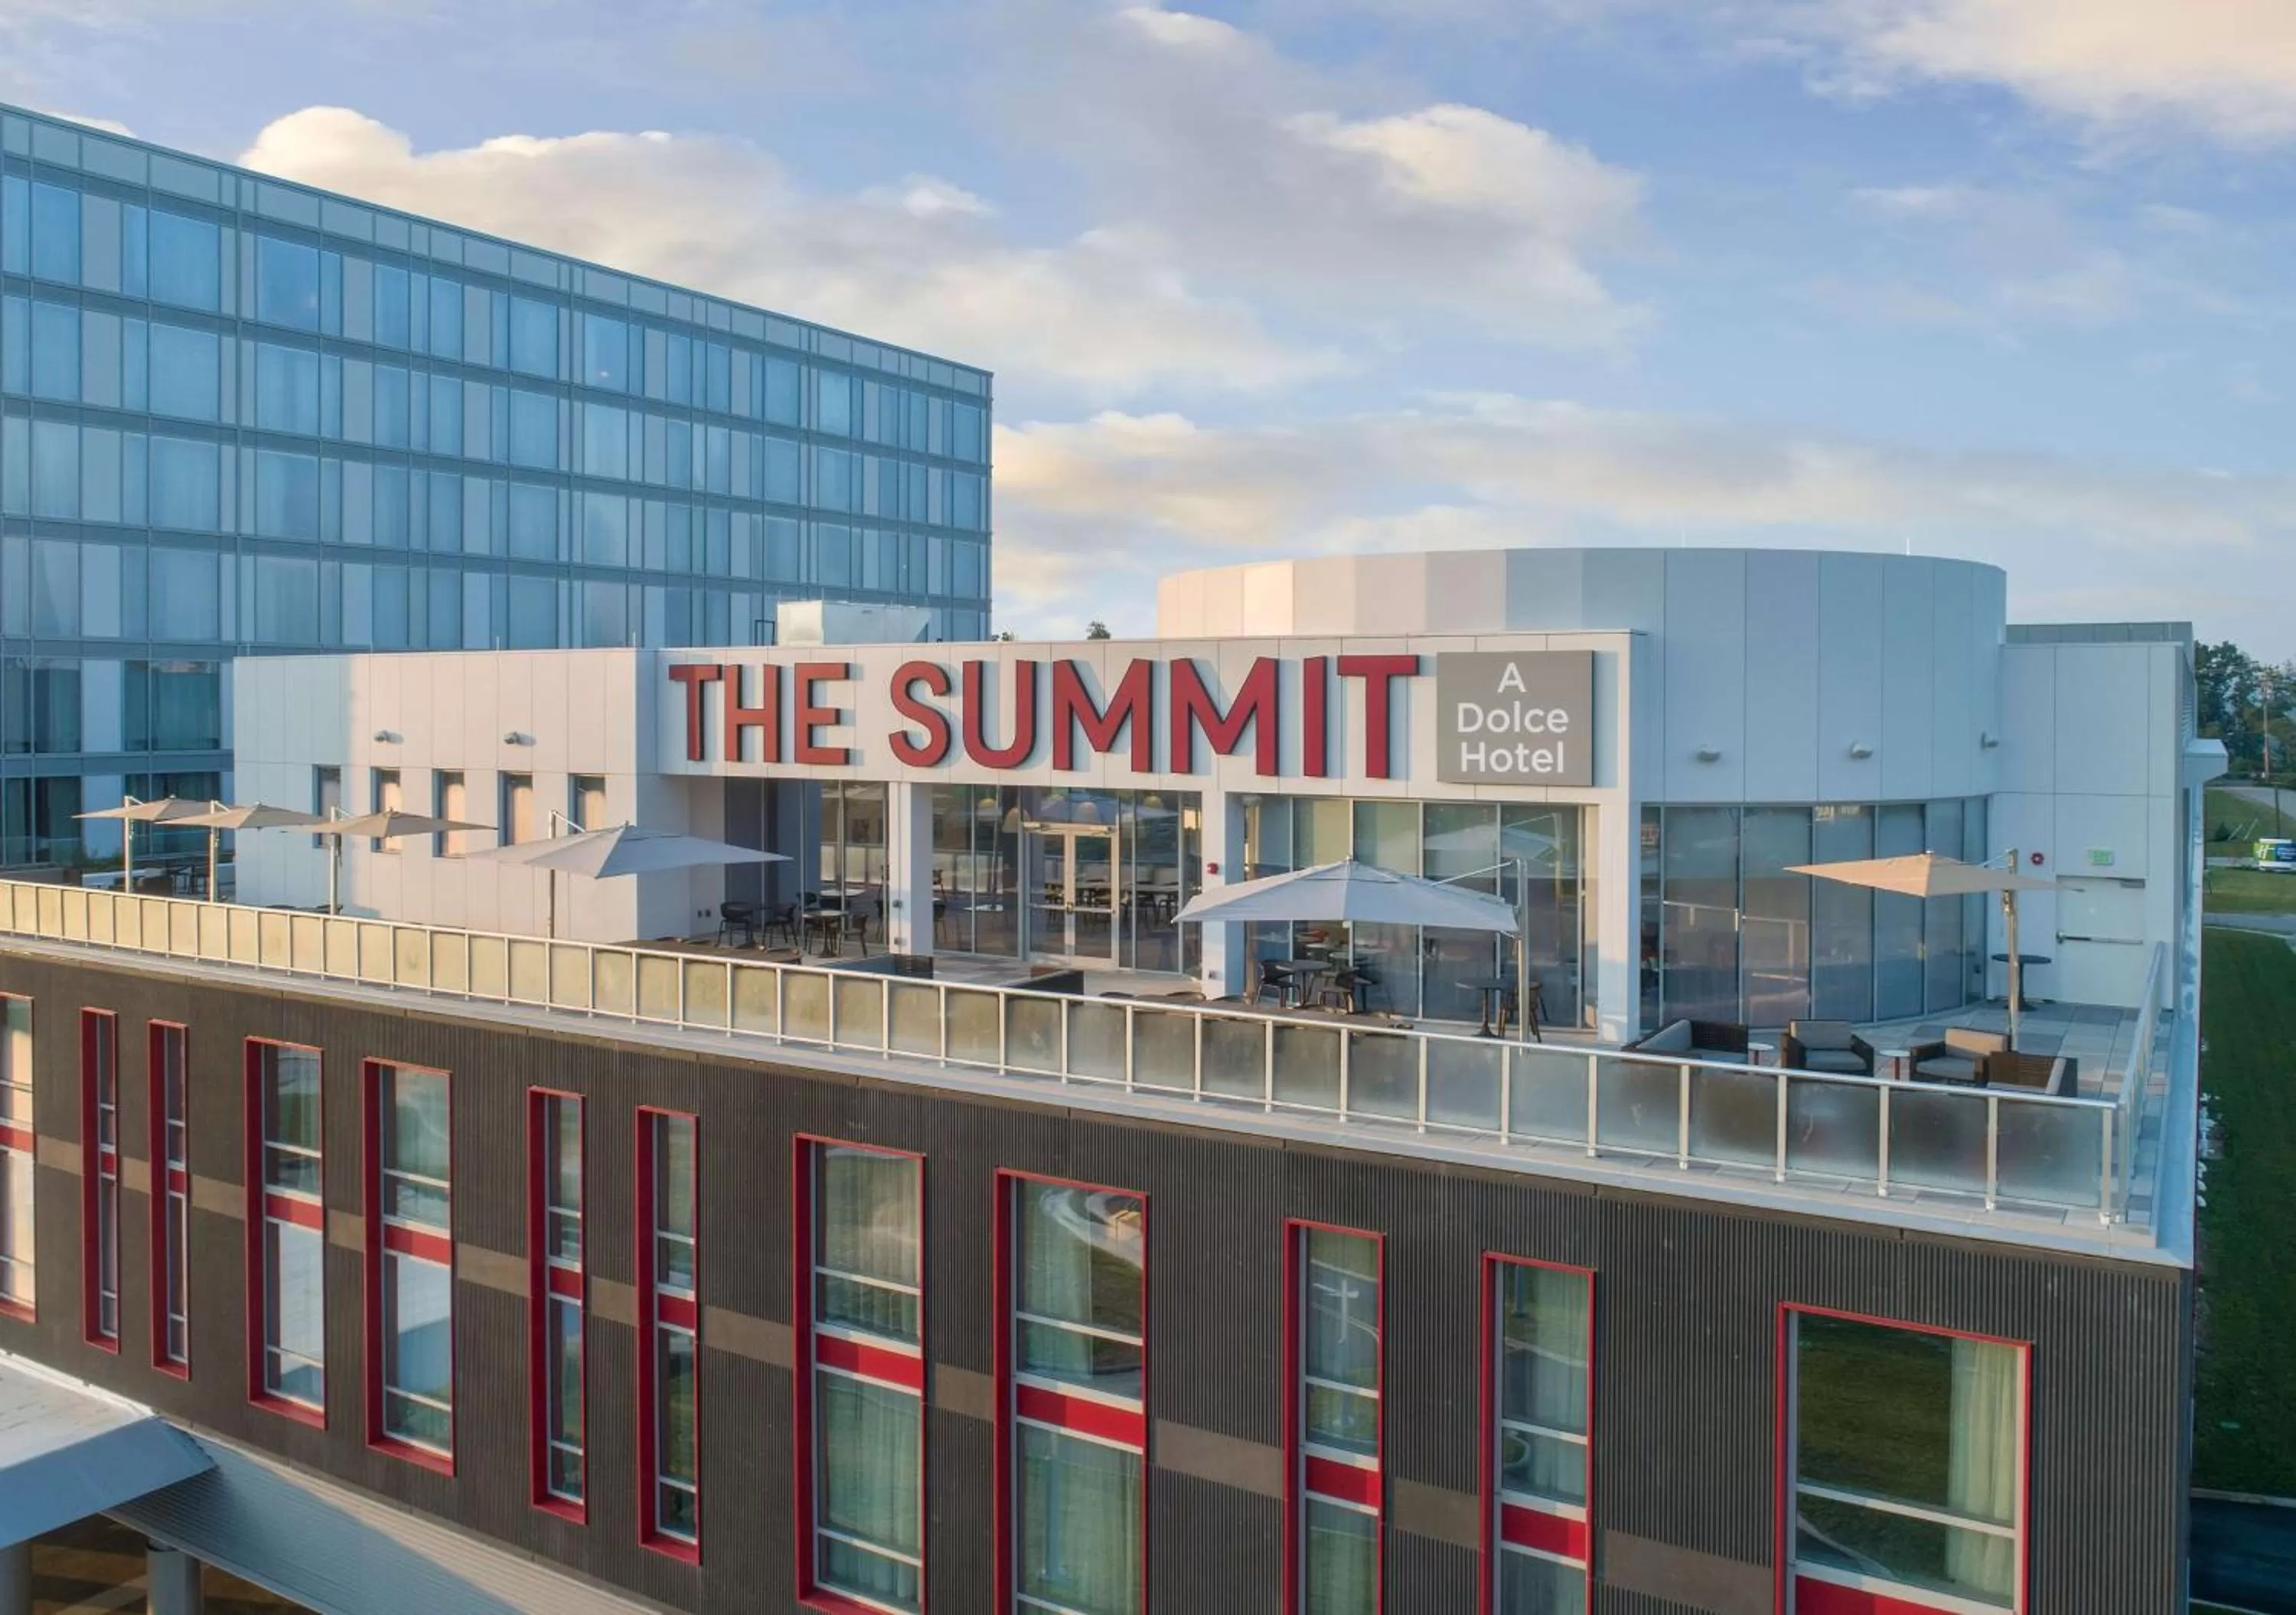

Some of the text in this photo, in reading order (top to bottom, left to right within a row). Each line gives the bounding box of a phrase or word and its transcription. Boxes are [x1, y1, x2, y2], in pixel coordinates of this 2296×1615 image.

[1497, 662, 1527, 693] A
[669, 654, 1420, 779] THE SUMMIT
[1457, 701, 1569, 733] Dolce
[1461, 741, 1564, 773] Hotel
